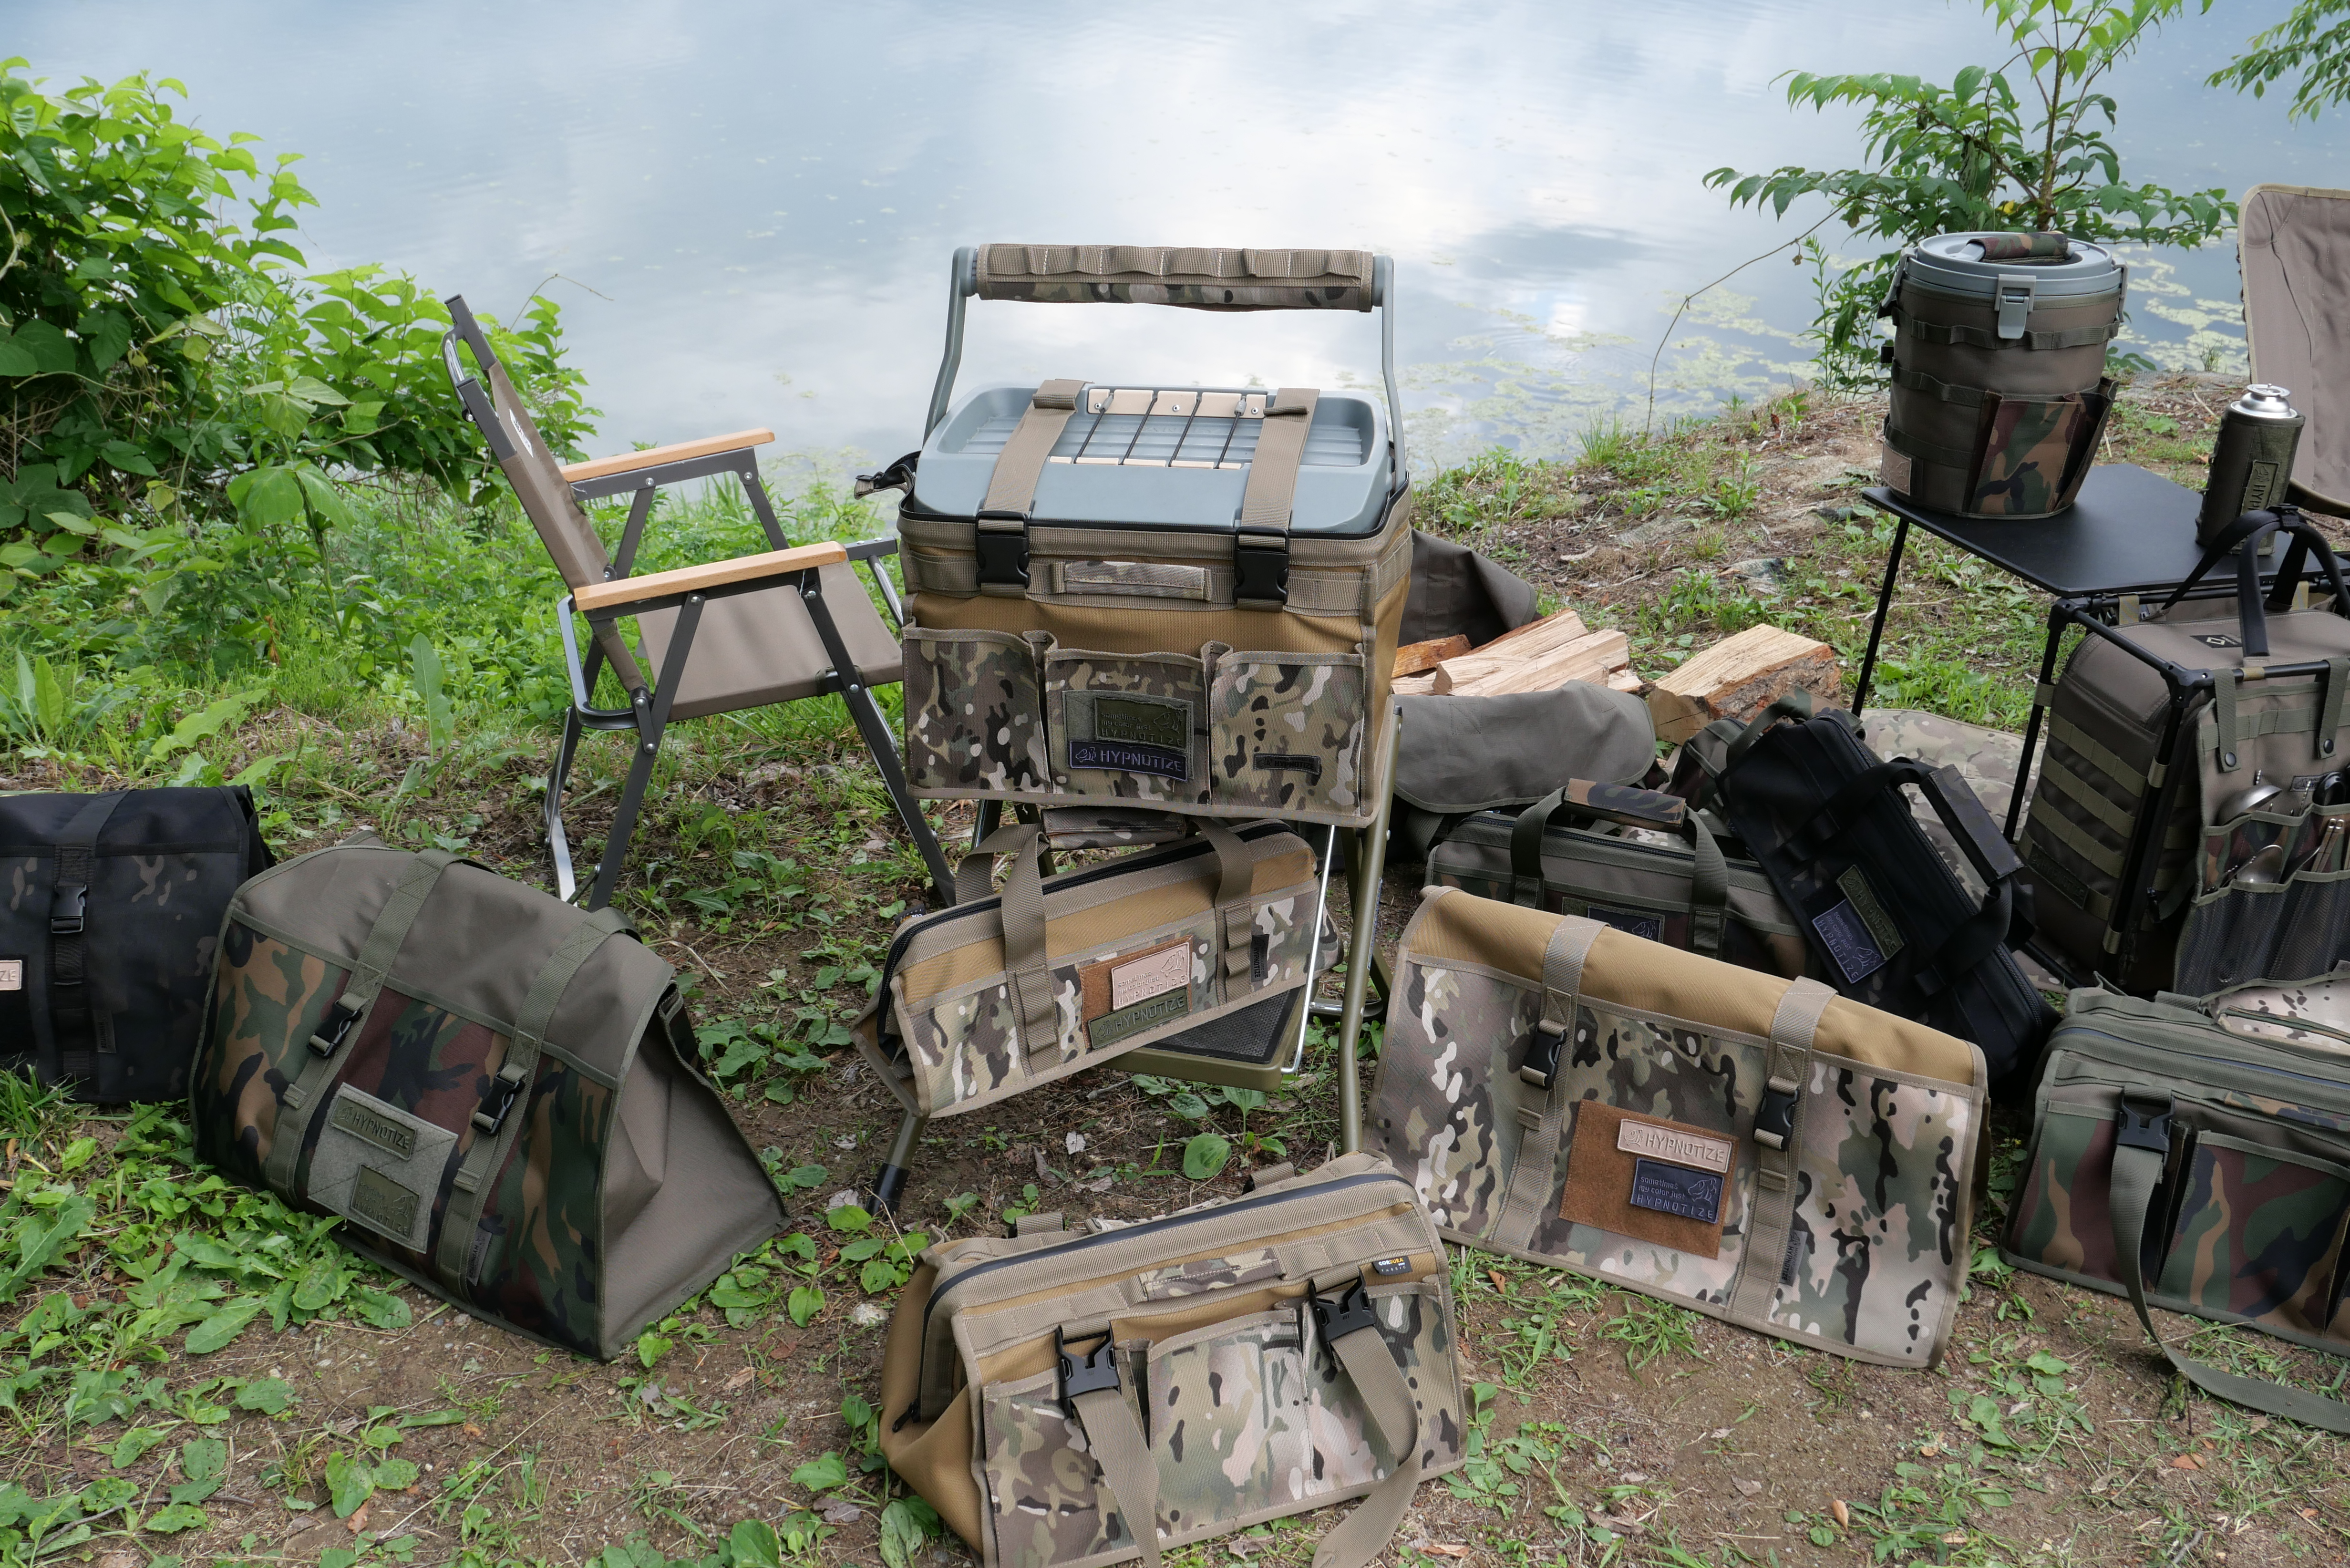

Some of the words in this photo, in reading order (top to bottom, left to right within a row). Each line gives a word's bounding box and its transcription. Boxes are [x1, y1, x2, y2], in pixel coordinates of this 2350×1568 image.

[1101, 712, 1142, 722] sometimes
[1101, 719, 1113, 728] my
[1101, 728, 1183, 747] HYPNOTIZE
[1100, 750, 1182, 772] HYPNOTIZE
[1274, 761, 1314, 770] HYPNOTIZE
[1826, 916, 1834, 924] my
[1833, 924, 1843, 939] color
[1841, 938, 1851, 951] just
[1834, 912, 1854, 941] sometimes
[1855, 890, 1896, 952] HYPNOTIZE
[1817, 919, 1859, 978] HYPNOTIZE
[1118, 970, 1152, 988] sometimes
[1118, 988, 1127, 996] my
[1128, 980, 1144, 991] color
[1145, 975, 1159, 985] just
[1118, 975, 1185, 1006] HYPNOTIZE
[1114, 995, 1185, 1032] HYPNOTIZE
[352, 1111, 411, 1150] HYPNOTIZE
[1646, 1133, 1725, 1163] HYPNOTIZE
[1639, 1185, 1649, 1194] my
[1651, 1186, 1670, 1197] color
[1670, 1189, 1685, 1200] just
[1640, 1176, 1678, 1190] sometimes
[355, 1200, 408, 1236] HYPNOTIZE
[1636, 1194, 1713, 1219] HYPNOTIZE
[1378, 1258, 1404, 1266] CORDURA
[1782, 1246, 1794, 1280] HYPNOTIZE
